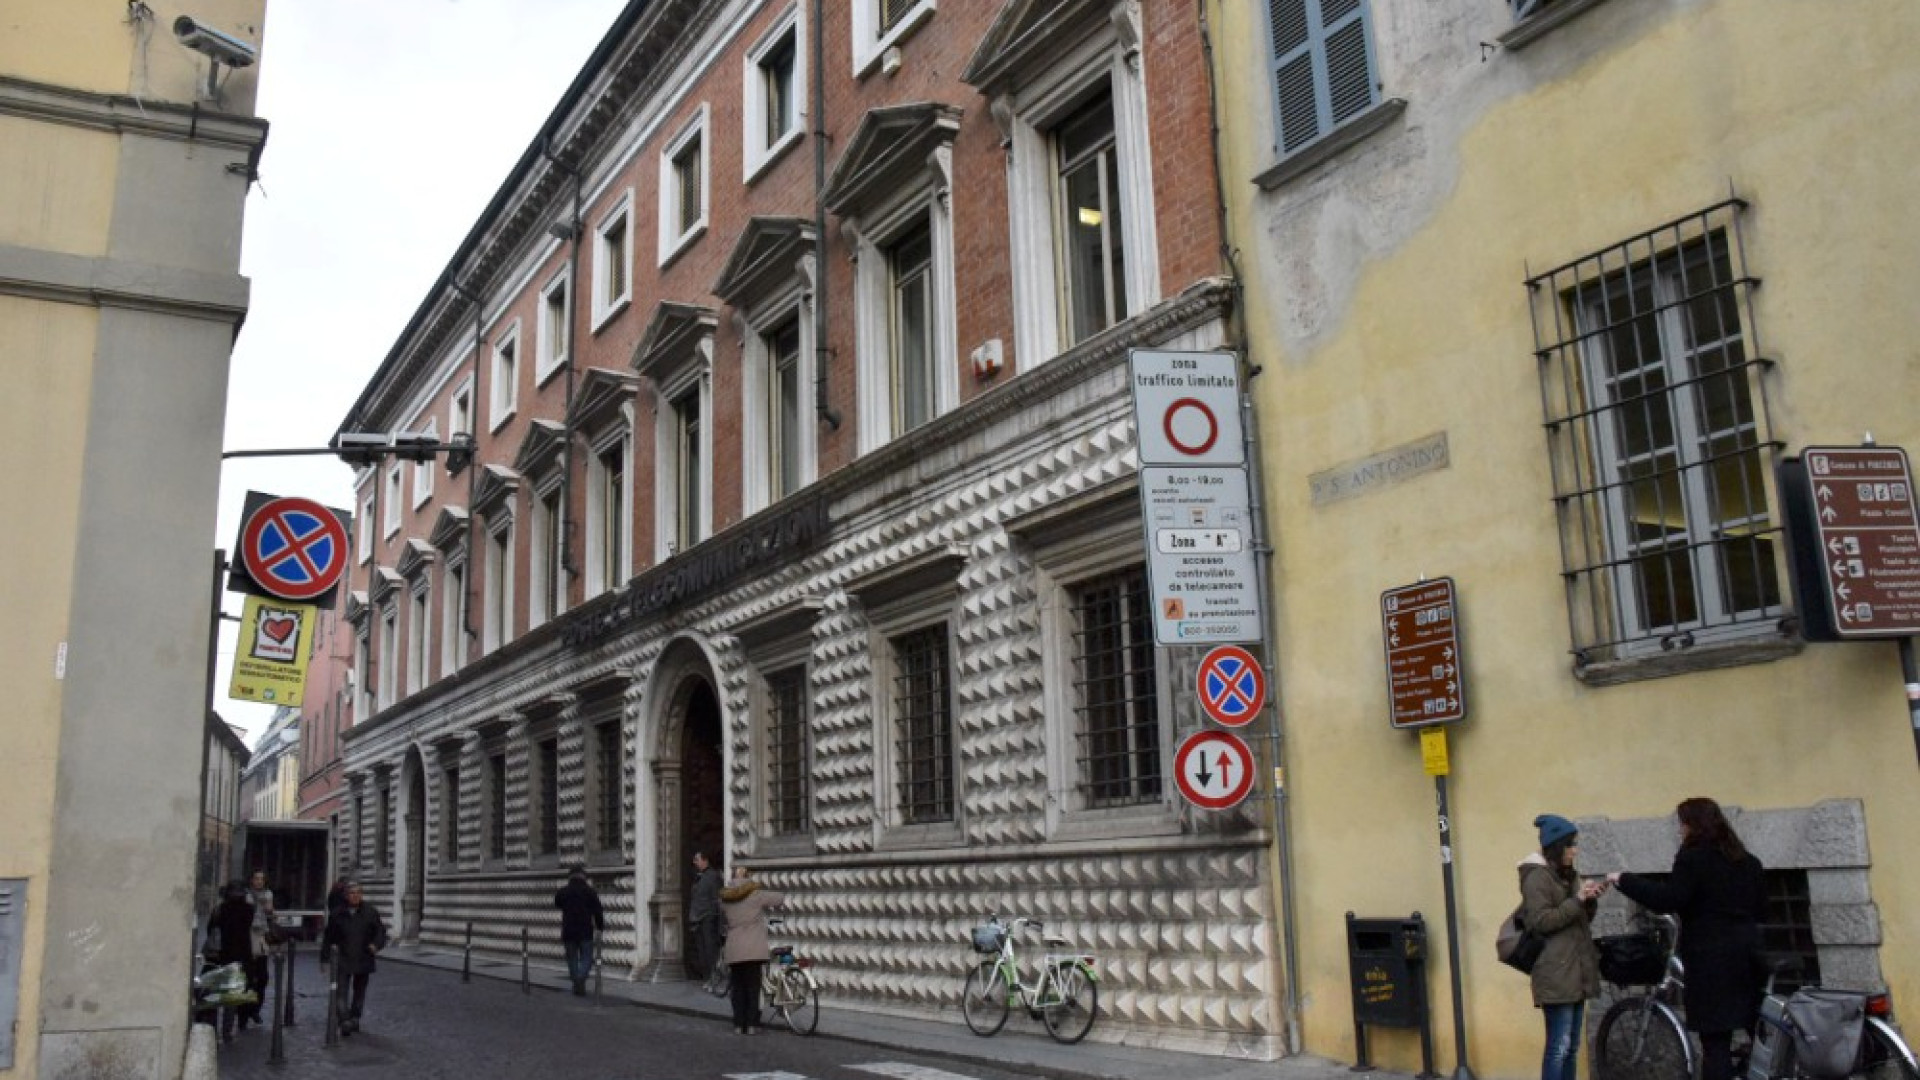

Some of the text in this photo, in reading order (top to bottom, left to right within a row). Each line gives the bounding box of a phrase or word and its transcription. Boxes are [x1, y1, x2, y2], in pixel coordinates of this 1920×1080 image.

[1171, 360, 1197, 369] zona
[1138, 373, 1234, 388] traffico limitato
[1351, 443, 1445, 488] ANTONINO
[1171, 533, 1196, 548] Zona
[1182, 557, 1223, 565] accesso
[1175, 568, 1235, 578] controllato
[1184, 581, 1243, 591] telecamere
